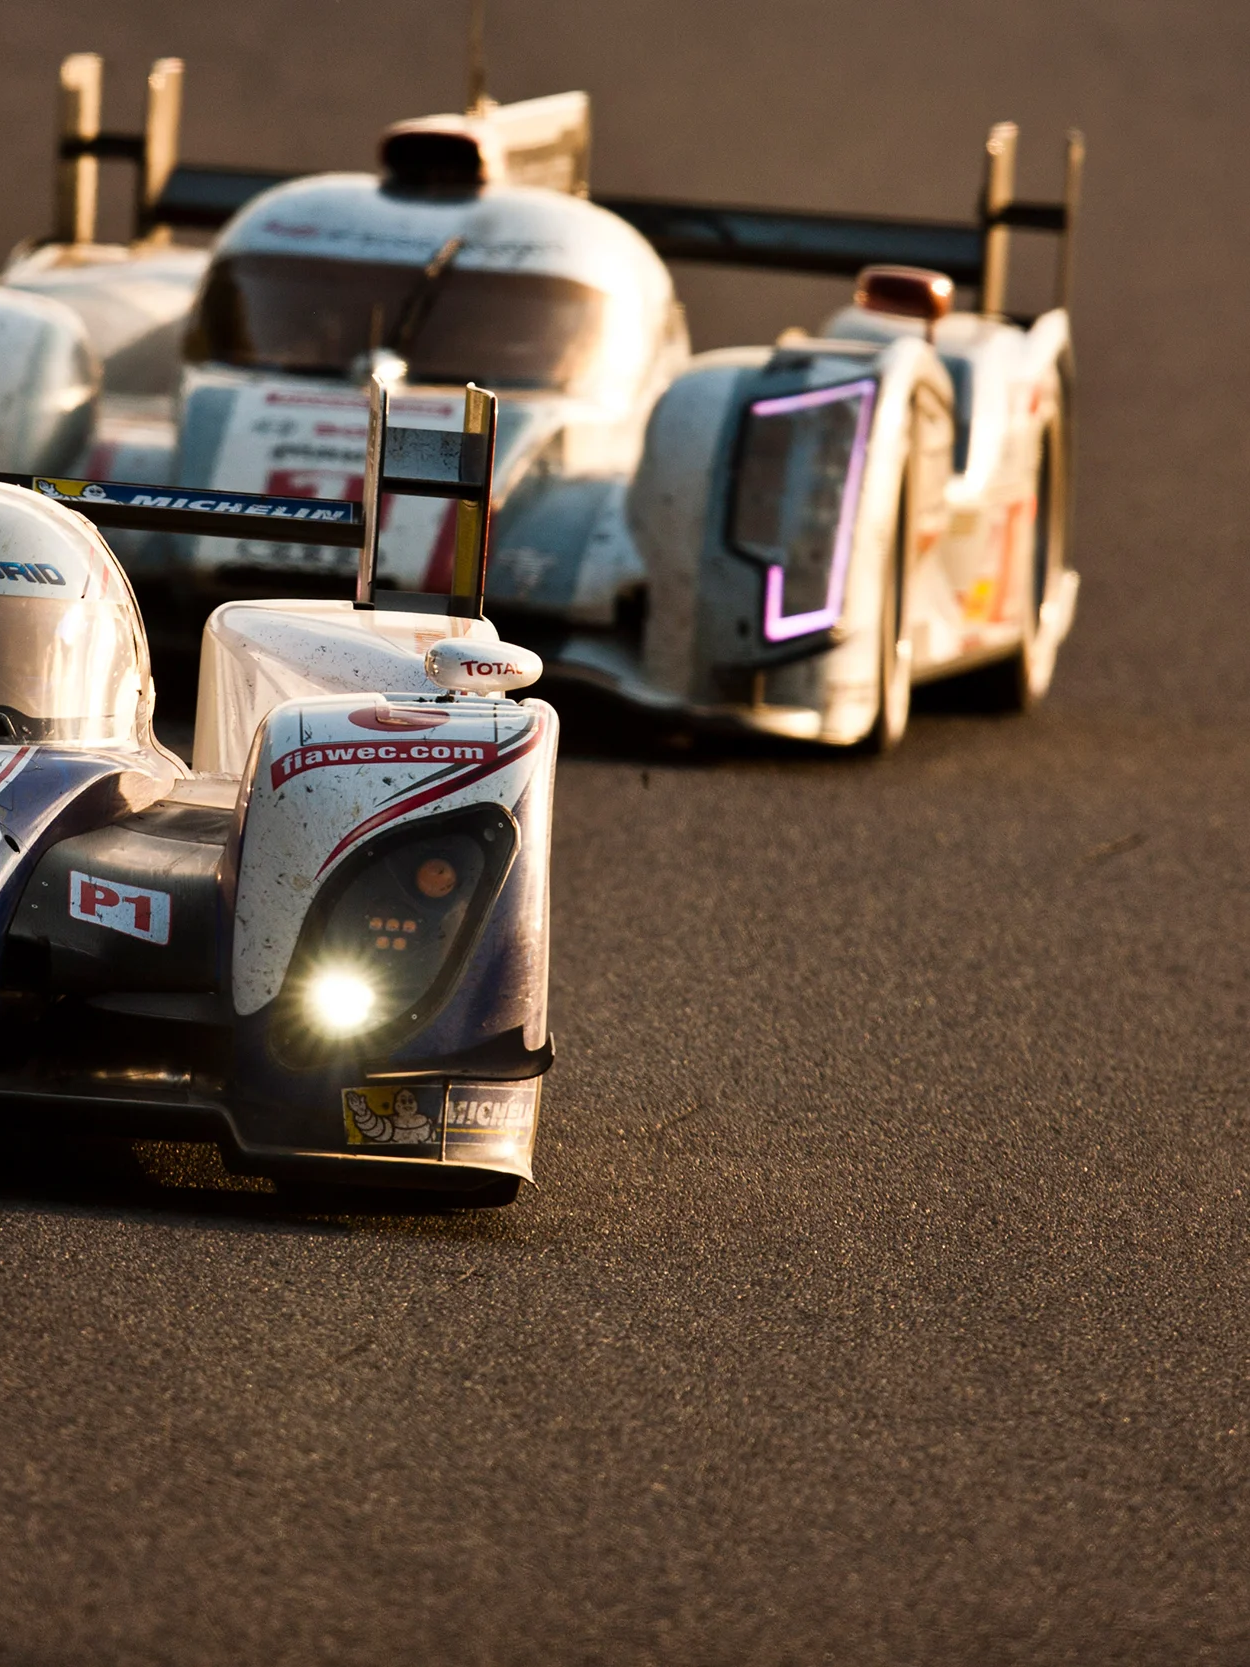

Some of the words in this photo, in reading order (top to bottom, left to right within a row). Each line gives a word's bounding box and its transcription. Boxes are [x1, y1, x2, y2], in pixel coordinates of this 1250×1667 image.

[131, 494, 344, 521] MICHELIN
[460, 660, 523, 676] TOTAL
[281, 745, 484, 773] fiawec.com
[80, 880, 151, 931] P1
